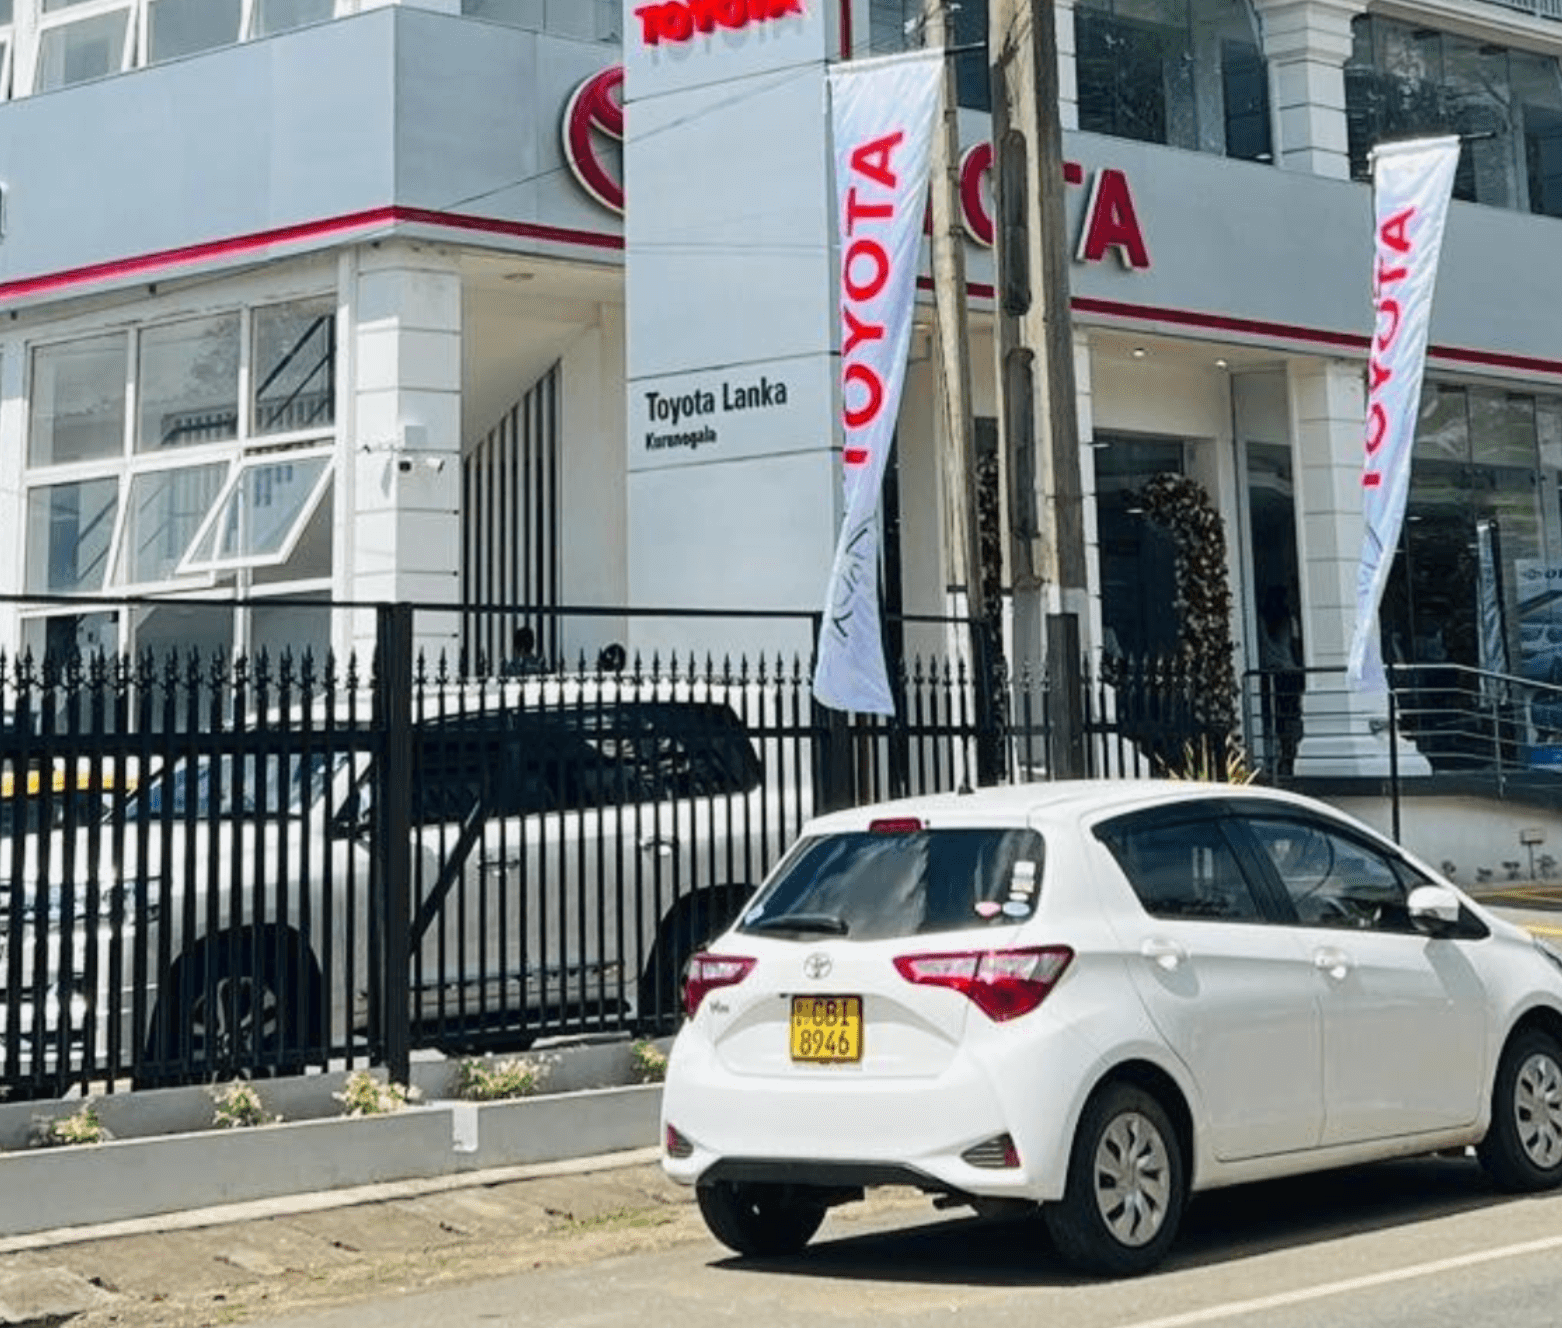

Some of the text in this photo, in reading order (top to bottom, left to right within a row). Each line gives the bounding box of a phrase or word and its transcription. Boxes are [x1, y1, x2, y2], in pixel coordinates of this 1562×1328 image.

[644, 375, 788, 427] Toyota Lanka
[811, 1000, 850, 1027] CBI
[799, 1028, 850, 1056] 8946
